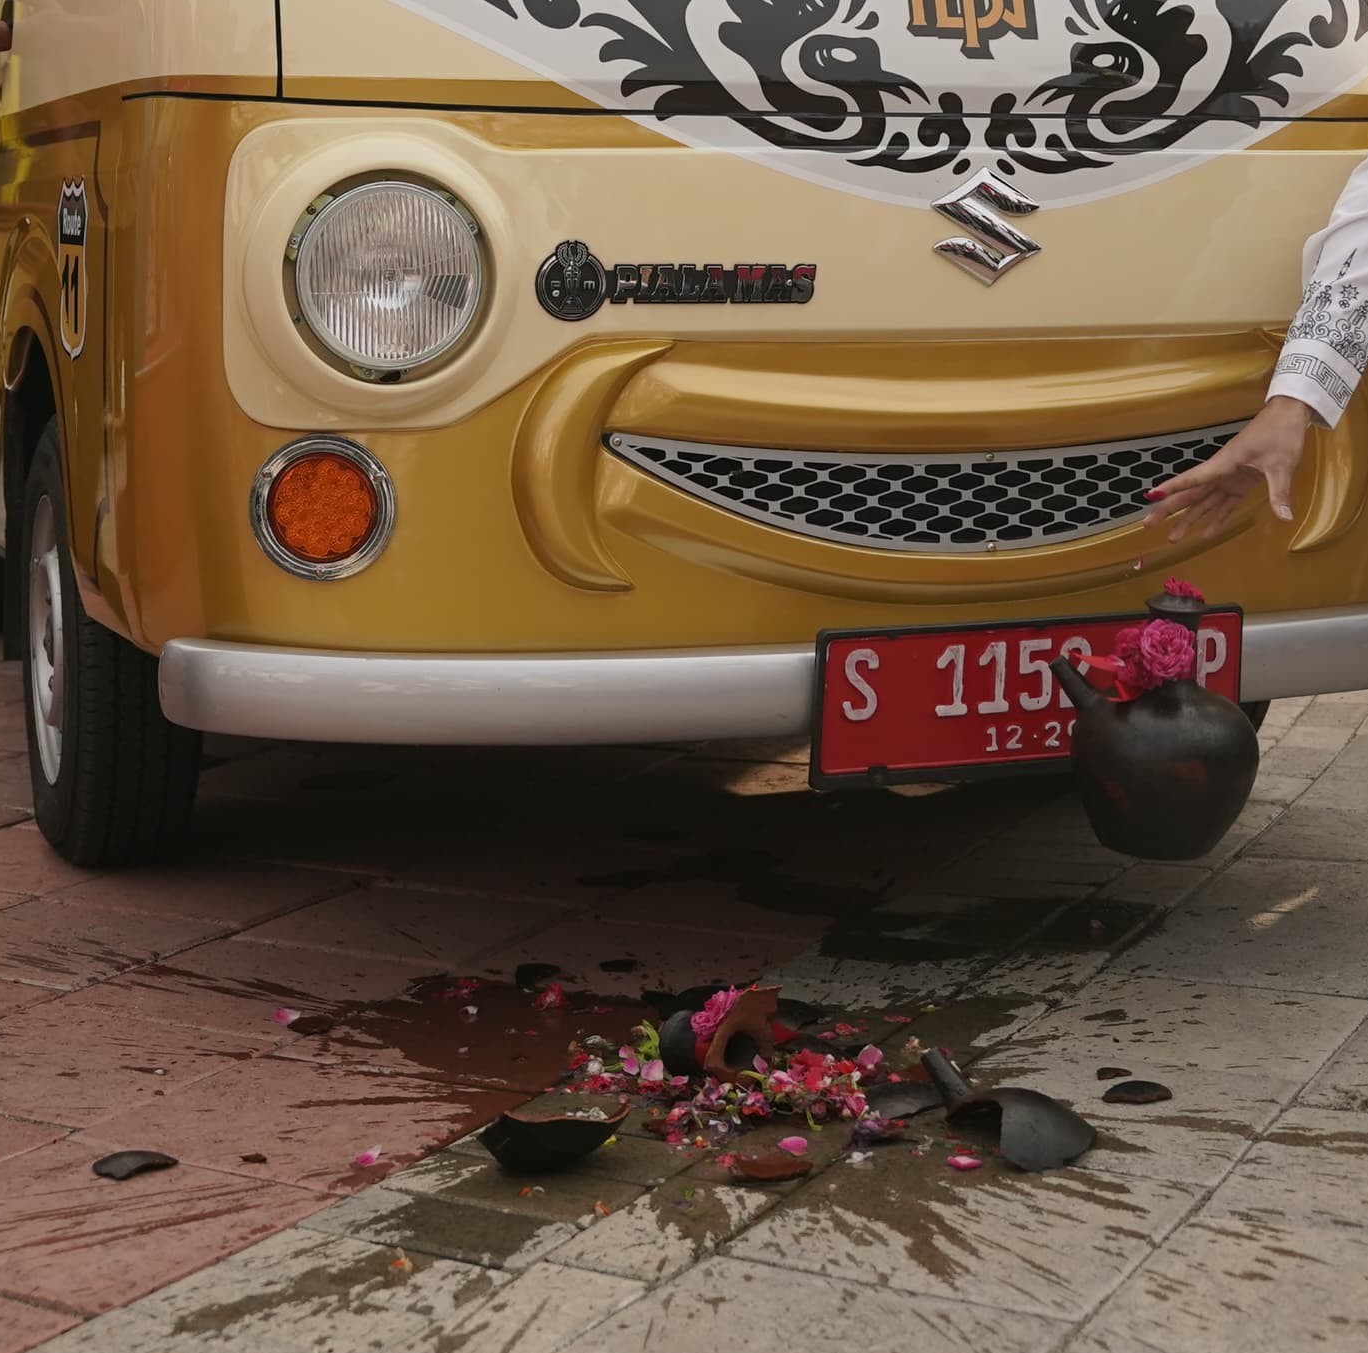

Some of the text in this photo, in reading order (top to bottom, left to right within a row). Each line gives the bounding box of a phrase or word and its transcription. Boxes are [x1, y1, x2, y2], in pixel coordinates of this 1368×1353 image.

[62, 207, 81, 236] Route
[61, 254, 79, 334] 11
[842, 648, 880, 721] S
